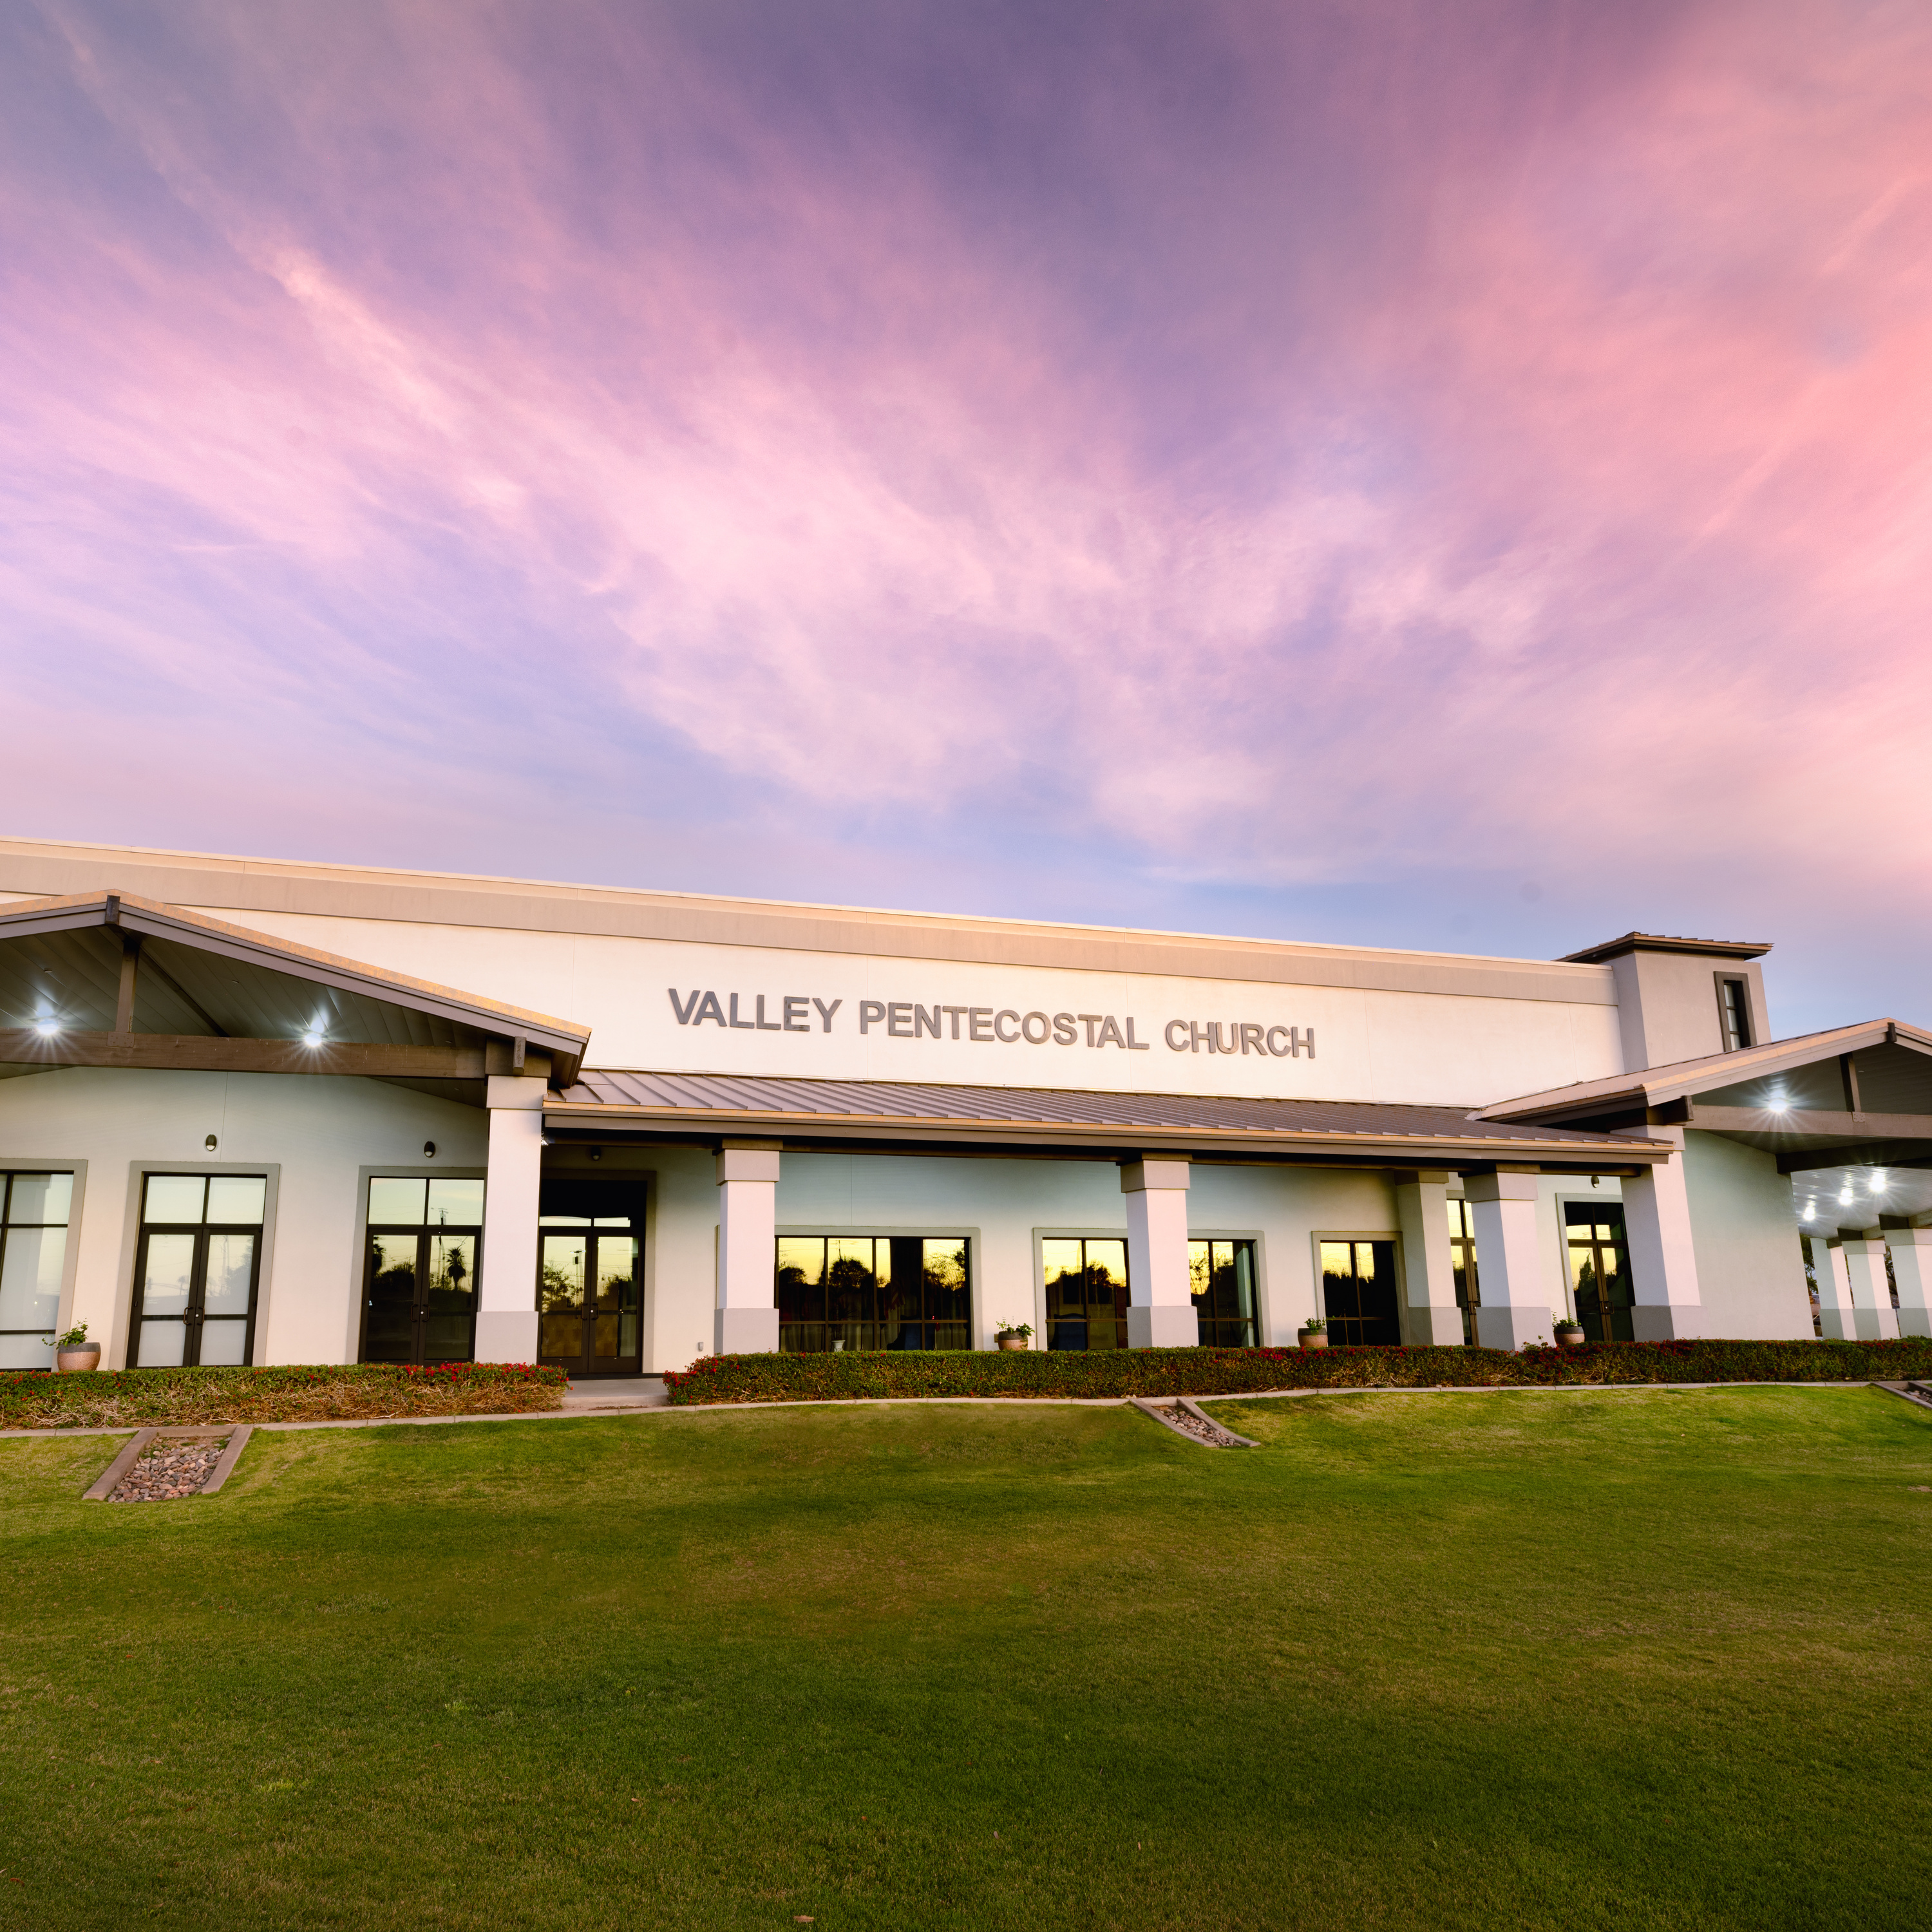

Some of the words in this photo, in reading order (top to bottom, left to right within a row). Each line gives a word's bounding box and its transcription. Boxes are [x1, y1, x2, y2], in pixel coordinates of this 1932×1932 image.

[668, 988, 843, 1033] VALLEY
[860, 1000, 1150, 1050] PENTECOSTAL
[1165, 1019, 1316, 1059] CHURCH
